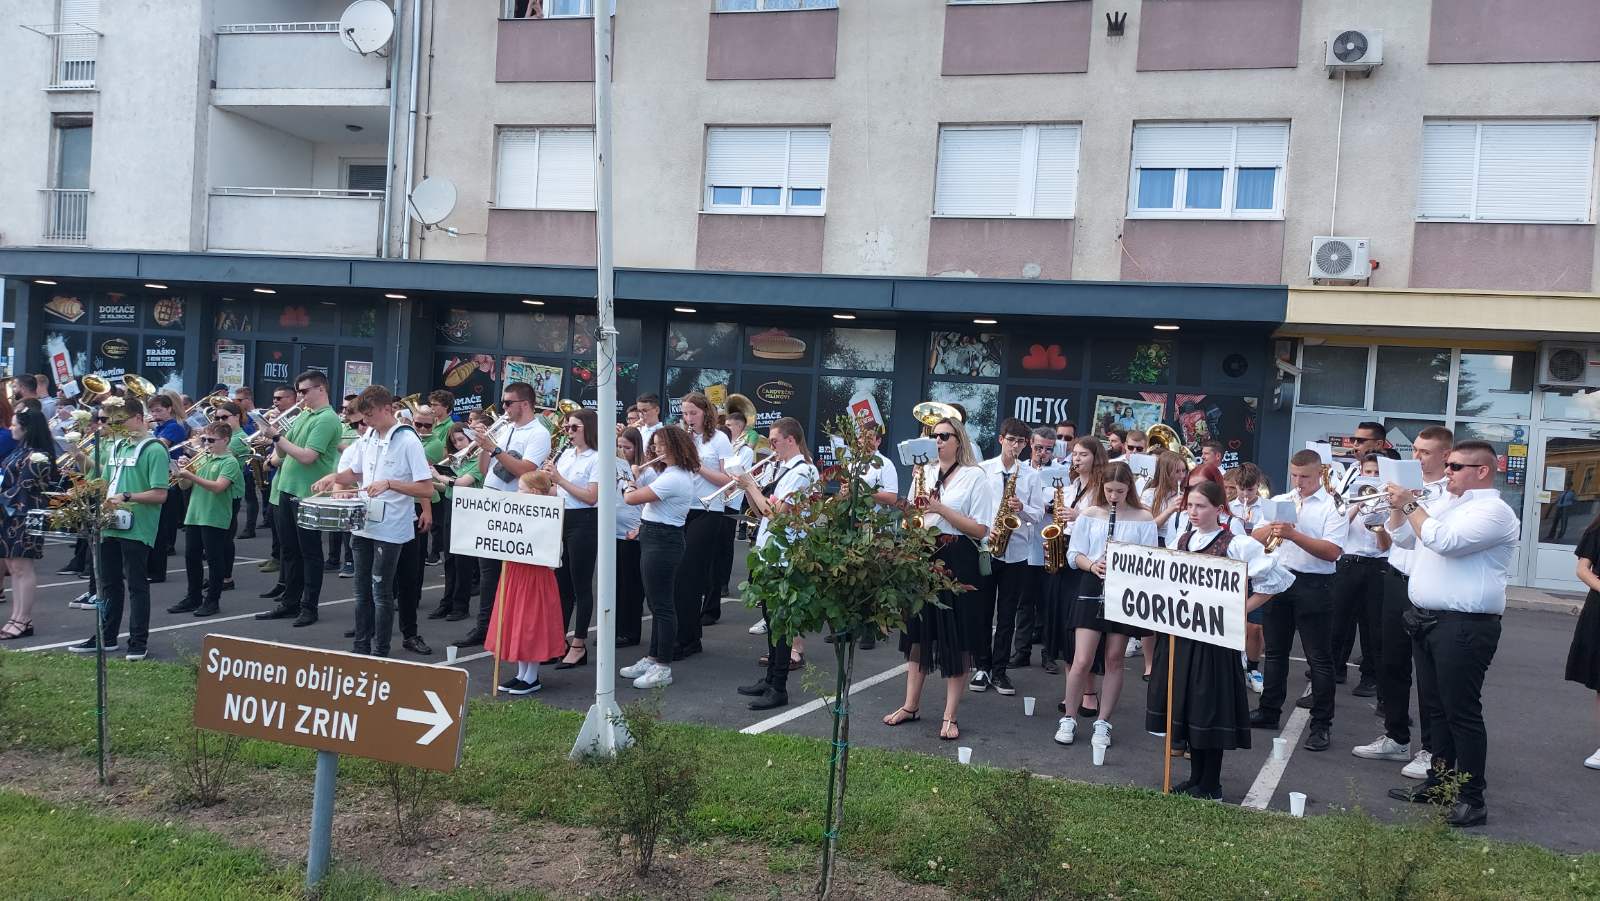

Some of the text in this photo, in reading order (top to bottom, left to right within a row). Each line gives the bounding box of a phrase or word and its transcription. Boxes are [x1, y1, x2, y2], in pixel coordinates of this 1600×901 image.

[264, 362, 289, 378] METSS
[454, 394, 482, 406] MAĆE
[1014, 396, 1069, 425] METSS
[756, 410, 782, 420] MAĆE
[455, 497, 560, 519] PUHAČKI ORKESTAR
[487, 519, 523, 534] GRADA
[475, 537, 534, 556] PRELOGA
[1111, 552, 1240, 593] PUHAČKI ORKESTAR
[1121, 588, 1225, 637] GORIČAN
[207, 648, 391, 706] Spomen obilježje
[223, 693, 359, 742] NOVI ZRIN
